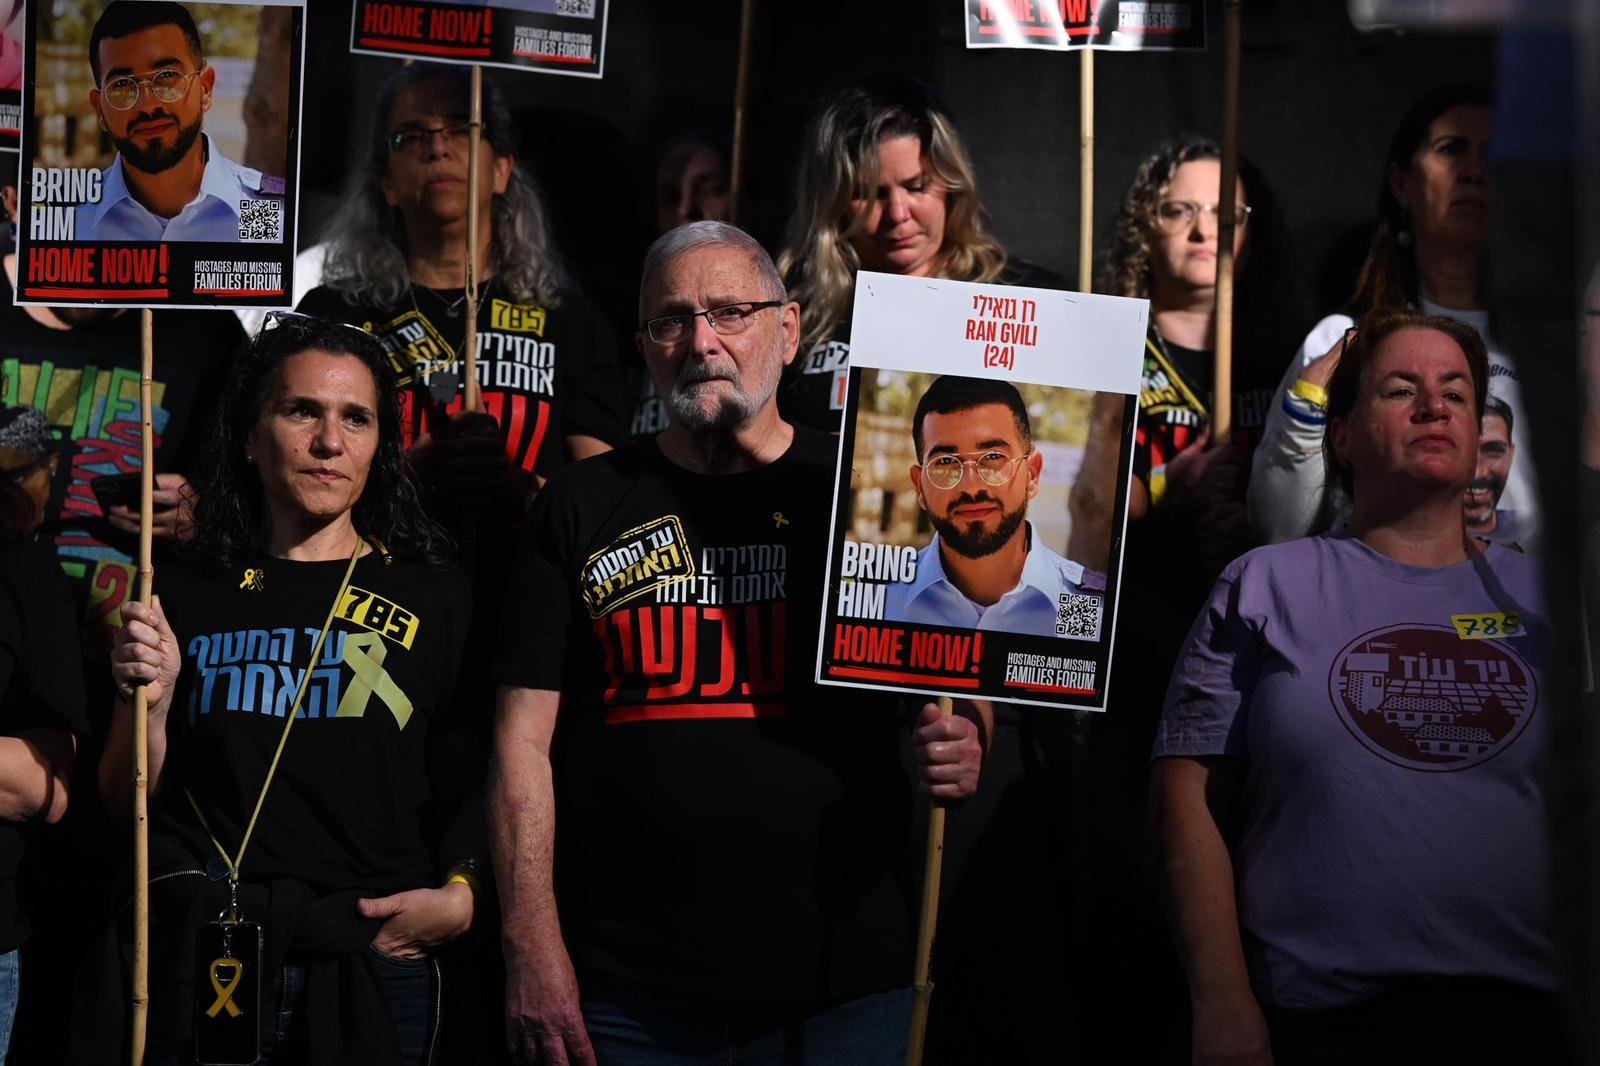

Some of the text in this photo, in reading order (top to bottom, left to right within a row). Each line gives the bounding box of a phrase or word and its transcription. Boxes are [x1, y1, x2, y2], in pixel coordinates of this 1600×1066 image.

[363, 3, 493, 45] HOME NOW!
[513, 37, 592, 60] FAMILIES FORUM
[31, 167, 103, 204] BRING
[30, 205, 76, 241] HIM
[28, 244, 170, 284] HOME NOW!
[194, 260, 282, 275] HOSTAGES AND MISSING
[194, 272, 281, 291] FAMILIES FORUM
[494, 302, 541, 332] 785
[972, 294, 1036, 323] רן גואילי
[965, 318, 1038, 347] RAN GVILI
[983, 343, 1015, 370] (24)
[495, 360, 555, 398] אותם
[587, 526, 676, 588] עד החטוף
[592, 543, 683, 607] האחרון
[702, 545, 787, 575] מחזירים
[841, 540, 918, 584] BRING
[656, 571, 788, 605] אותם הביתה
[837, 581, 887, 620] HIM
[344, 588, 412, 644] 785
[188, 626, 347, 672] עד החטוף
[594, 601, 787, 704] עכשיו
[832, 623, 985, 675] HOME NOW!
[1007, 652, 1097, 673] HOSTAGES AND MISSING
[1005, 666, 1096, 691] FAMILIES FORUM
[1463, 659, 1511, 682] ניר
[188, 663, 341, 728] האחרון
